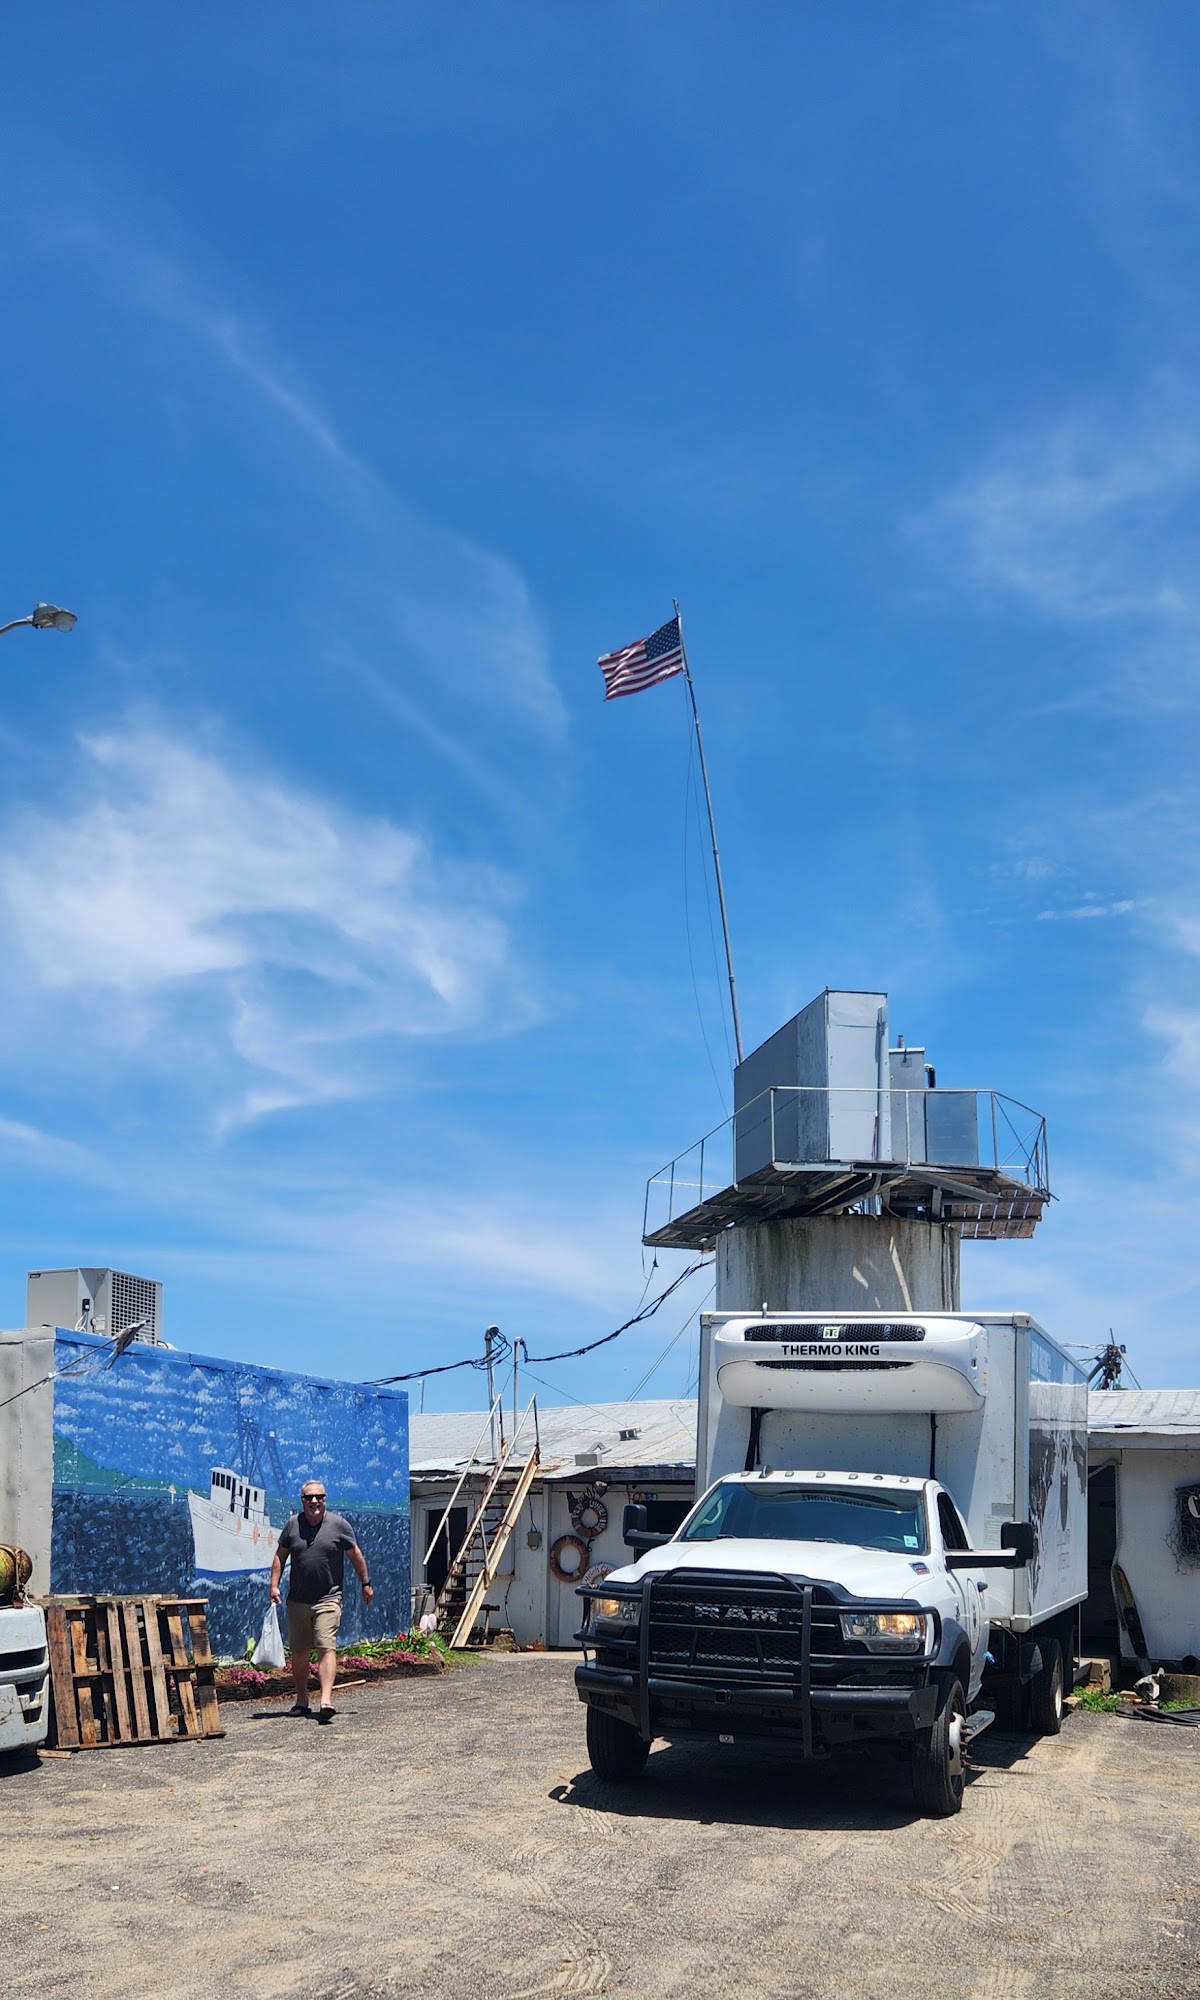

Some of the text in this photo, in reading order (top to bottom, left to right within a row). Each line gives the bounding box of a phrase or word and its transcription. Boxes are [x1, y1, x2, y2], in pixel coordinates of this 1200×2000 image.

[782, 1345, 880, 1356] THERMO KING
[694, 1605, 779, 1622] RAM
